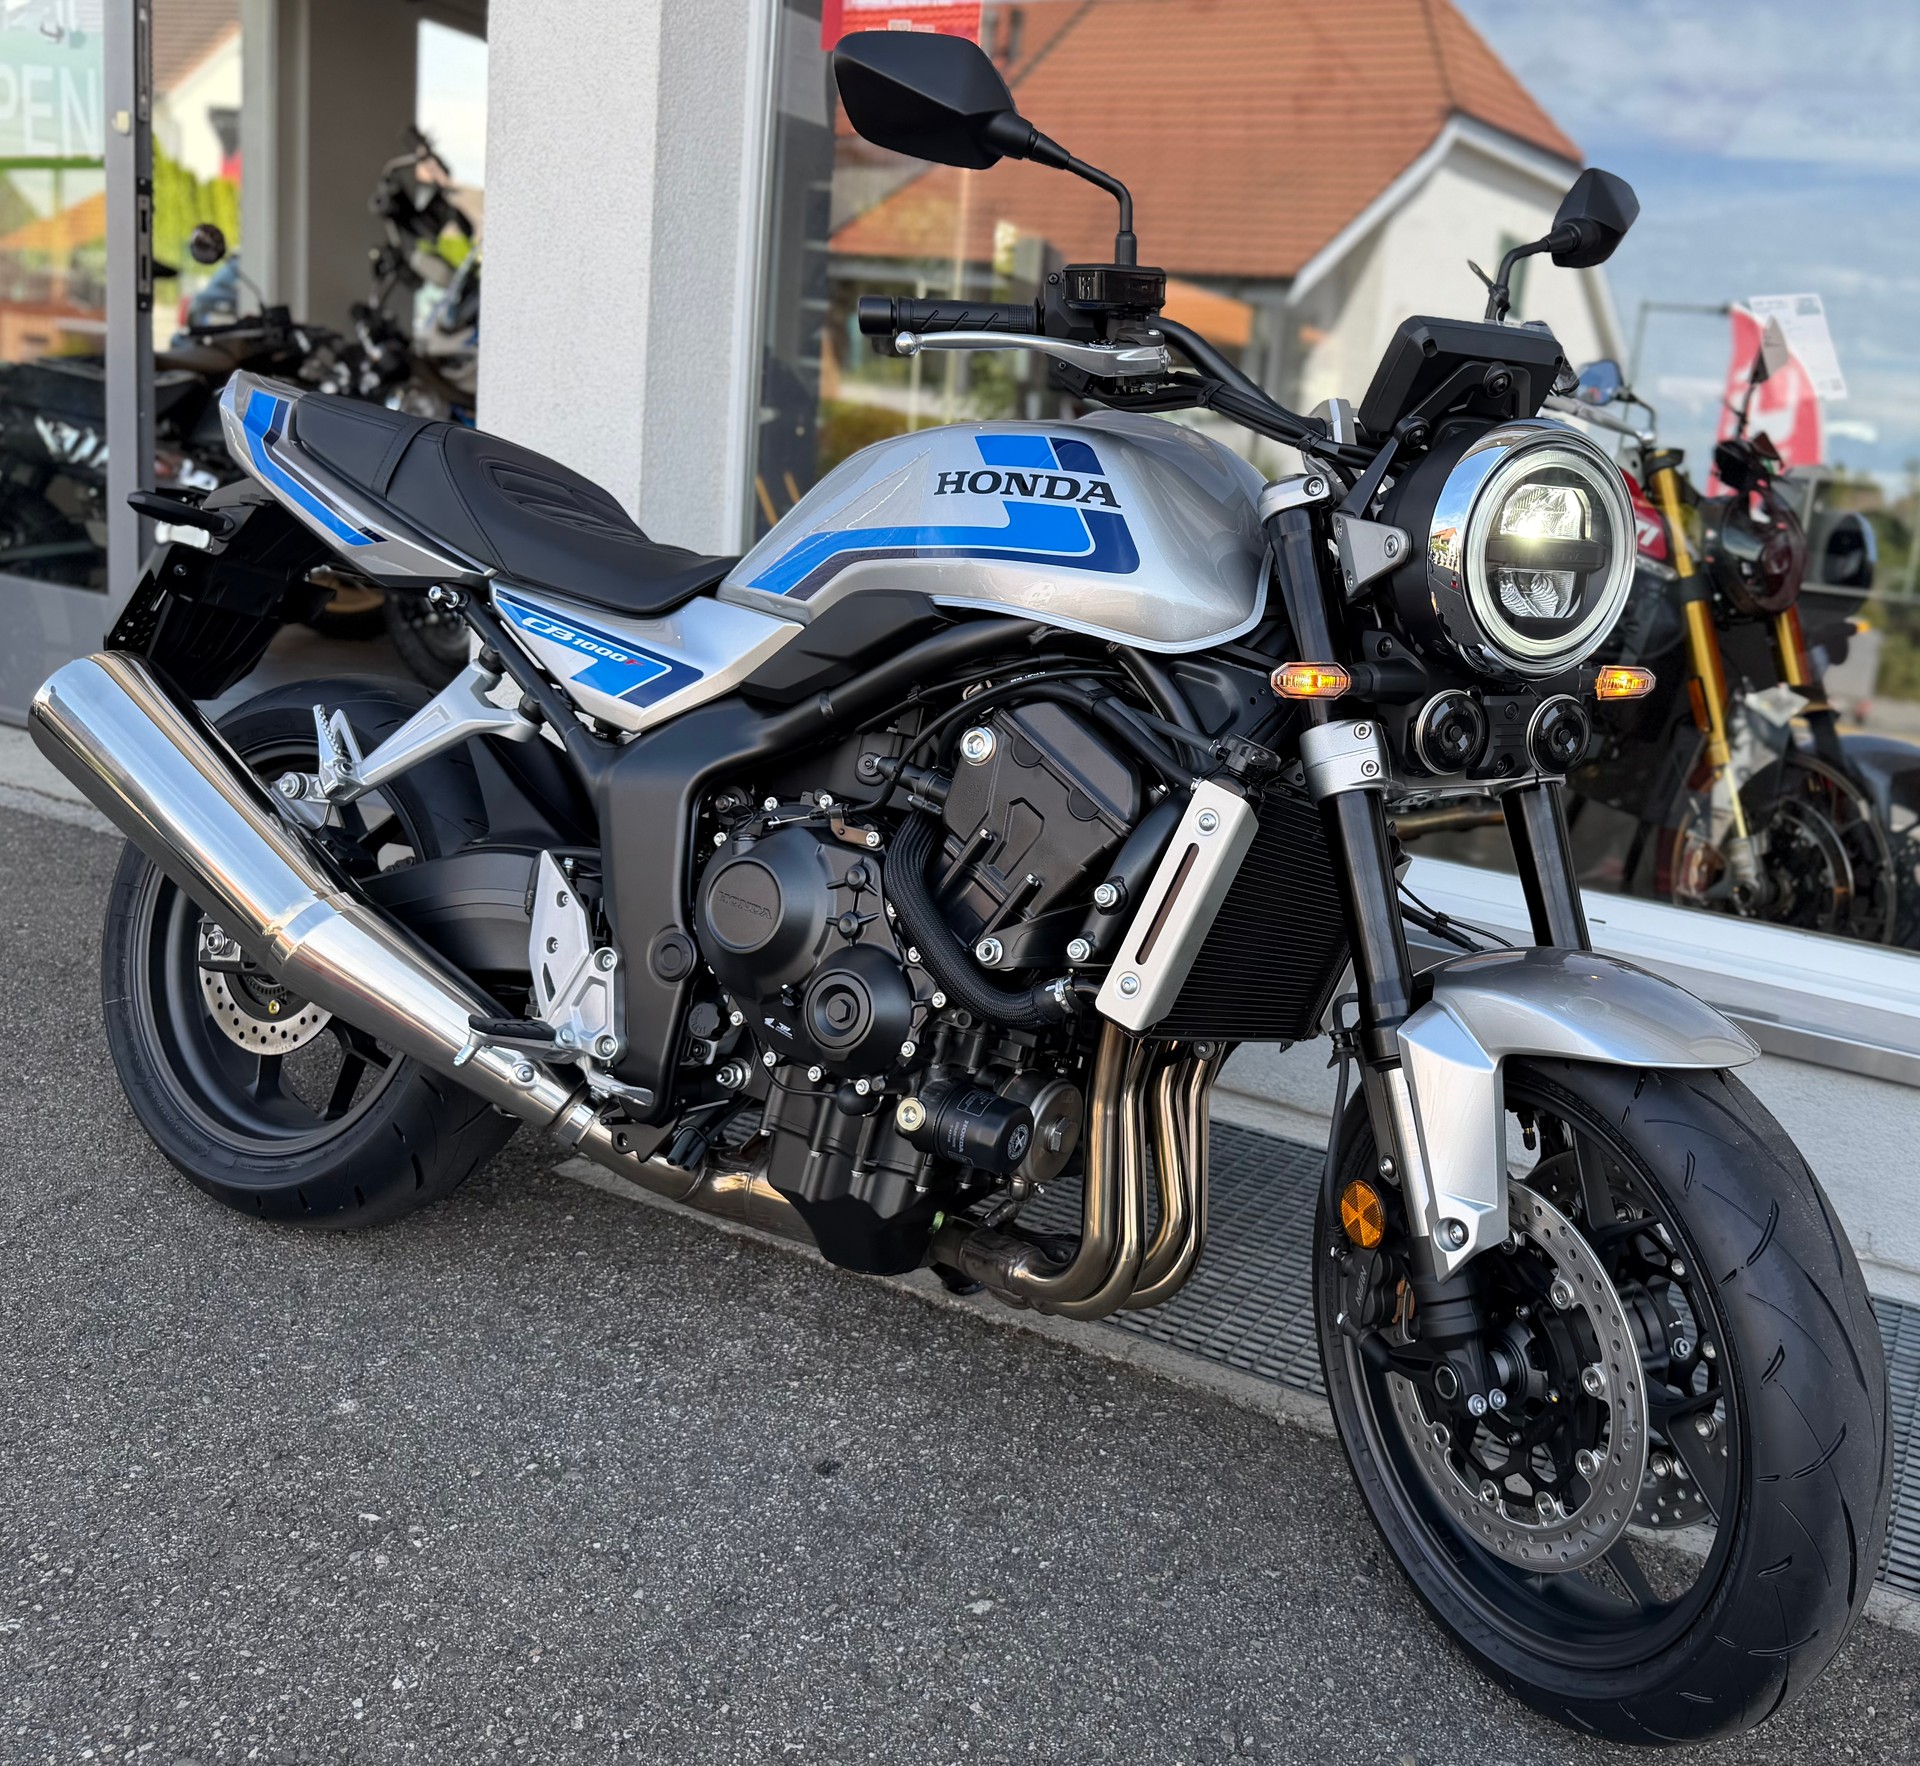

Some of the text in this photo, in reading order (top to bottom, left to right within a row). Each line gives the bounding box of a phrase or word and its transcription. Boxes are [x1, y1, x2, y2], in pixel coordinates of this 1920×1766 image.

[933, 470, 1122, 508] HONDA
[718, 889, 773, 920] HONDA
[958, 1119, 970, 1153] HONDA
